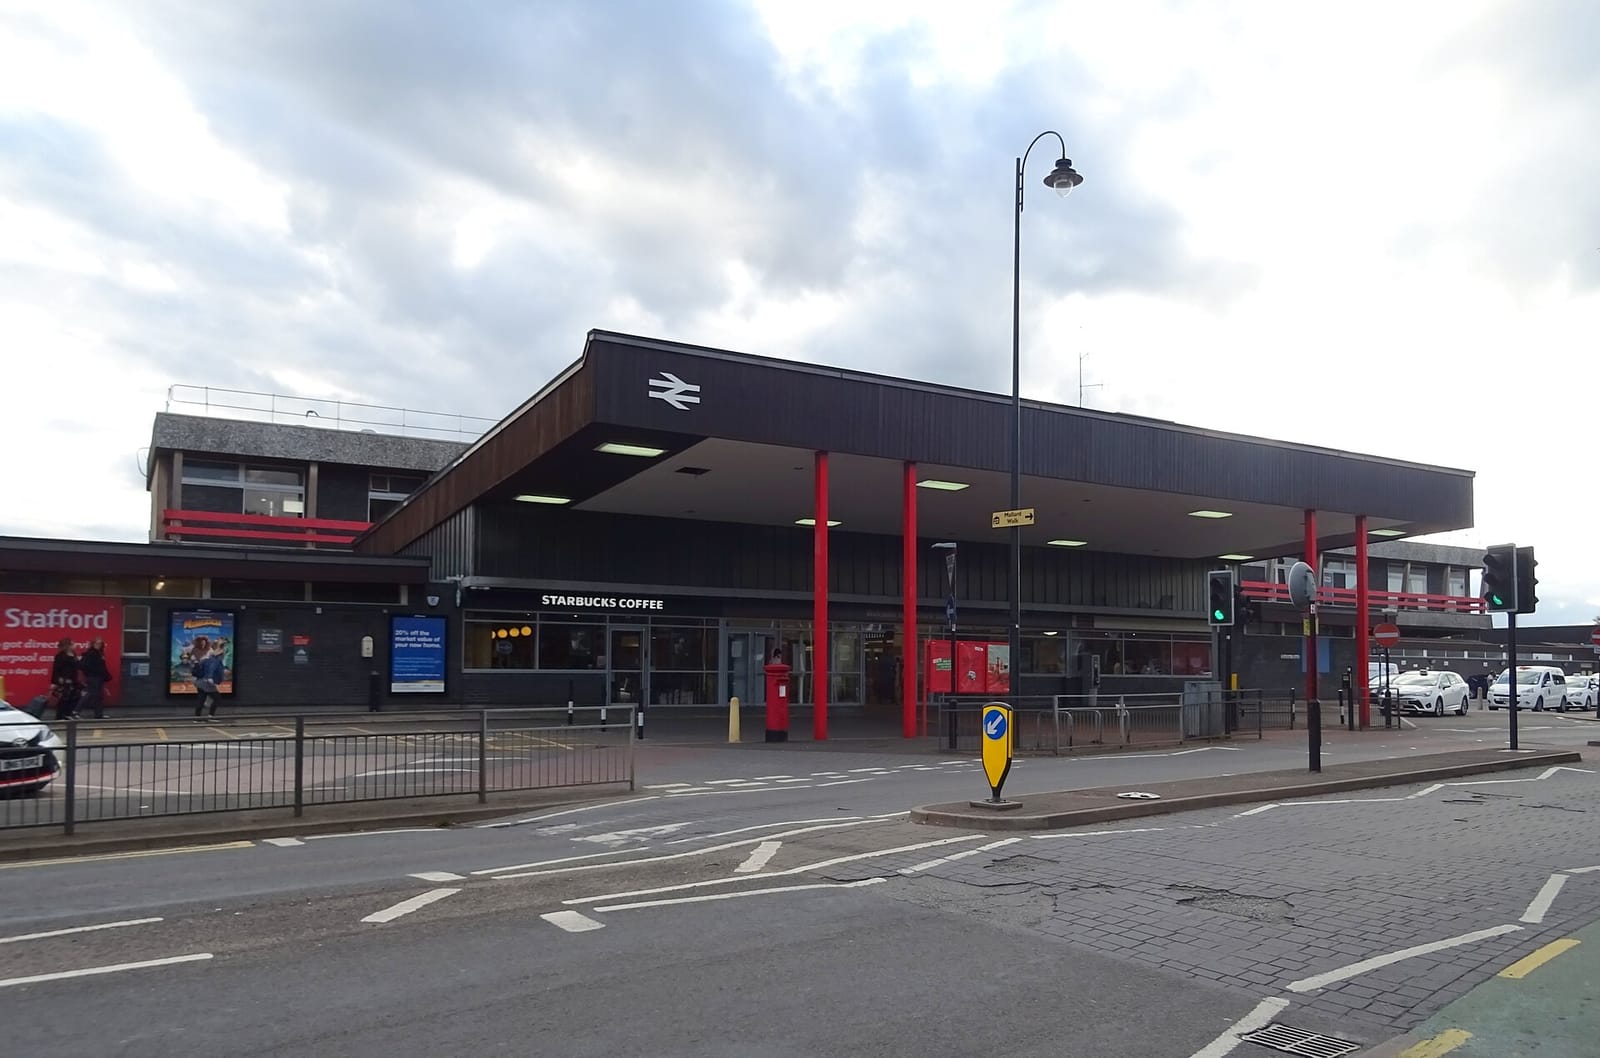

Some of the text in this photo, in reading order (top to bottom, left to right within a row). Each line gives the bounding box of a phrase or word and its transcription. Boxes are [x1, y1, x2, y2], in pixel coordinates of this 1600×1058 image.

[541, 595, 664, 610] STARBUCKS COFFEE
[5, 608, 108, 629] Stafford
[3, 641, 22, 650] got
[24, 639, 59, 649] direct
[0, 652, 37, 663] erpool
